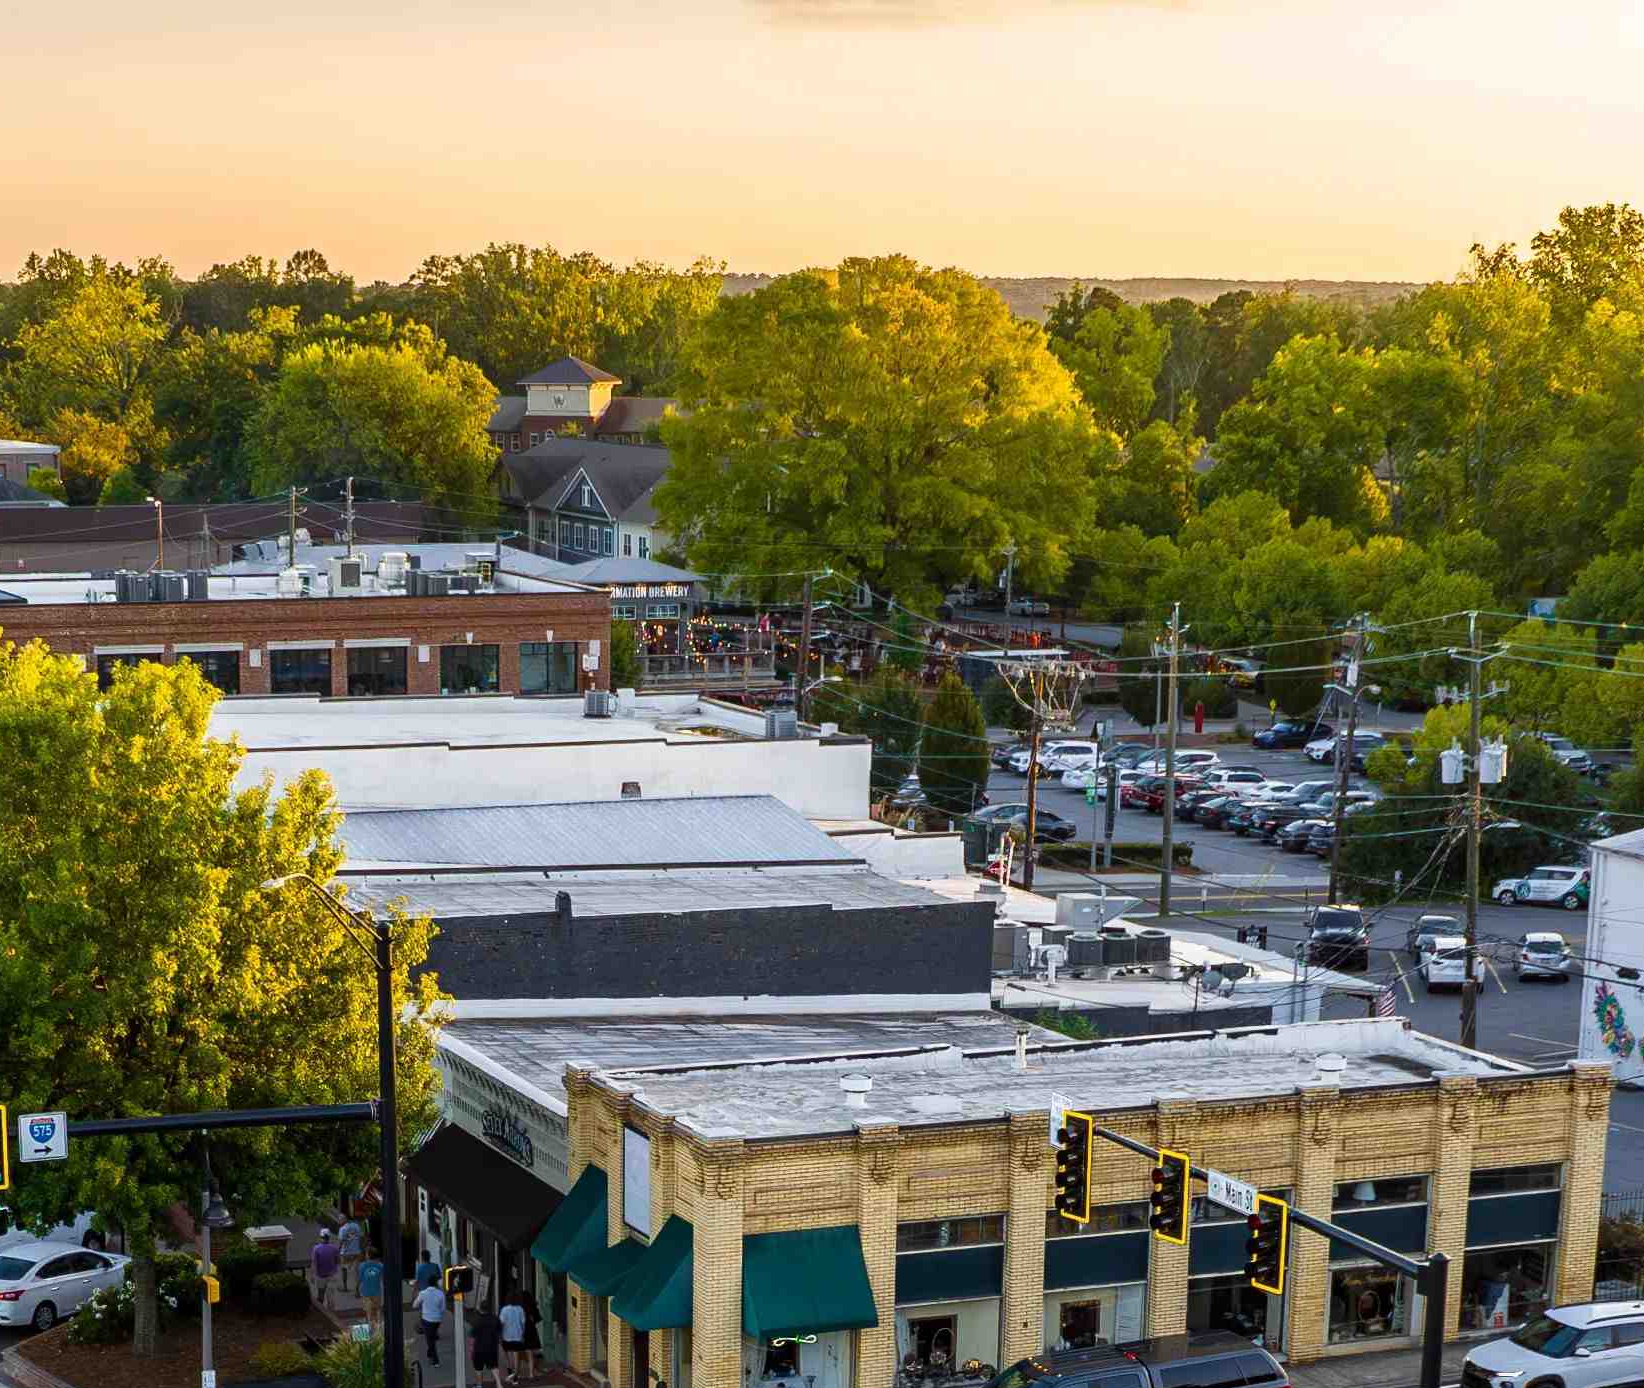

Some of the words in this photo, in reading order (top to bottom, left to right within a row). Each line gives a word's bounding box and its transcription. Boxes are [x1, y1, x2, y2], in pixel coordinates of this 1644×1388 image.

[649, 584, 690, 598] BREWERY
[33, 1124, 53, 1138] 575
[1225, 1181, 1243, 1206] Main
[1245, 1190, 1254, 1212] St
